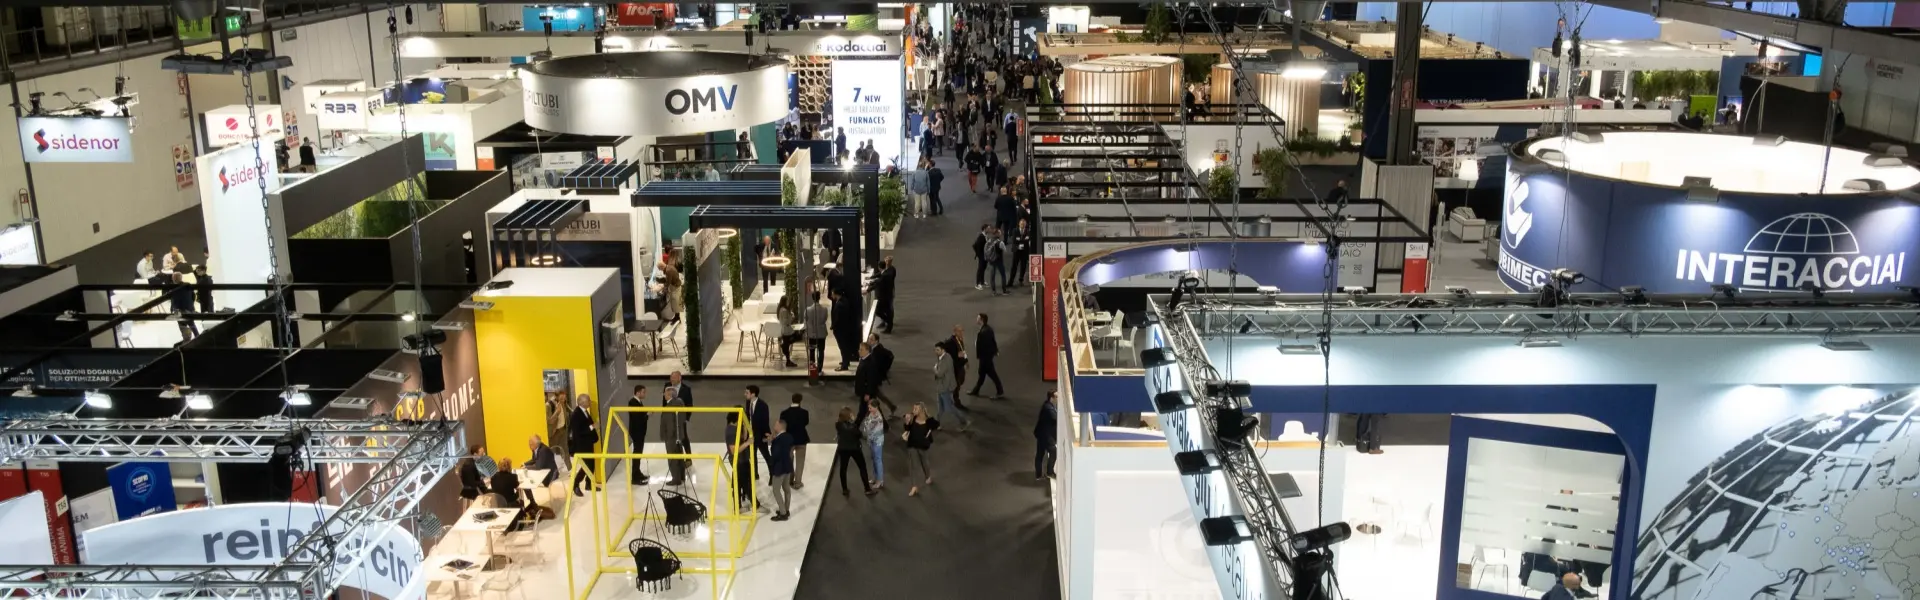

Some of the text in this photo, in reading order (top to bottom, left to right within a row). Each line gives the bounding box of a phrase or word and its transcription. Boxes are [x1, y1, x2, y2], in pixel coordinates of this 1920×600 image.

[665, 84, 738, 115] OMV
[853, 87, 881, 103] 7 NEW
[849, 116, 886, 124] FURNACES
[52, 134, 120, 150] sidenor
[1675, 248, 1906, 288] INTERACCIAI
